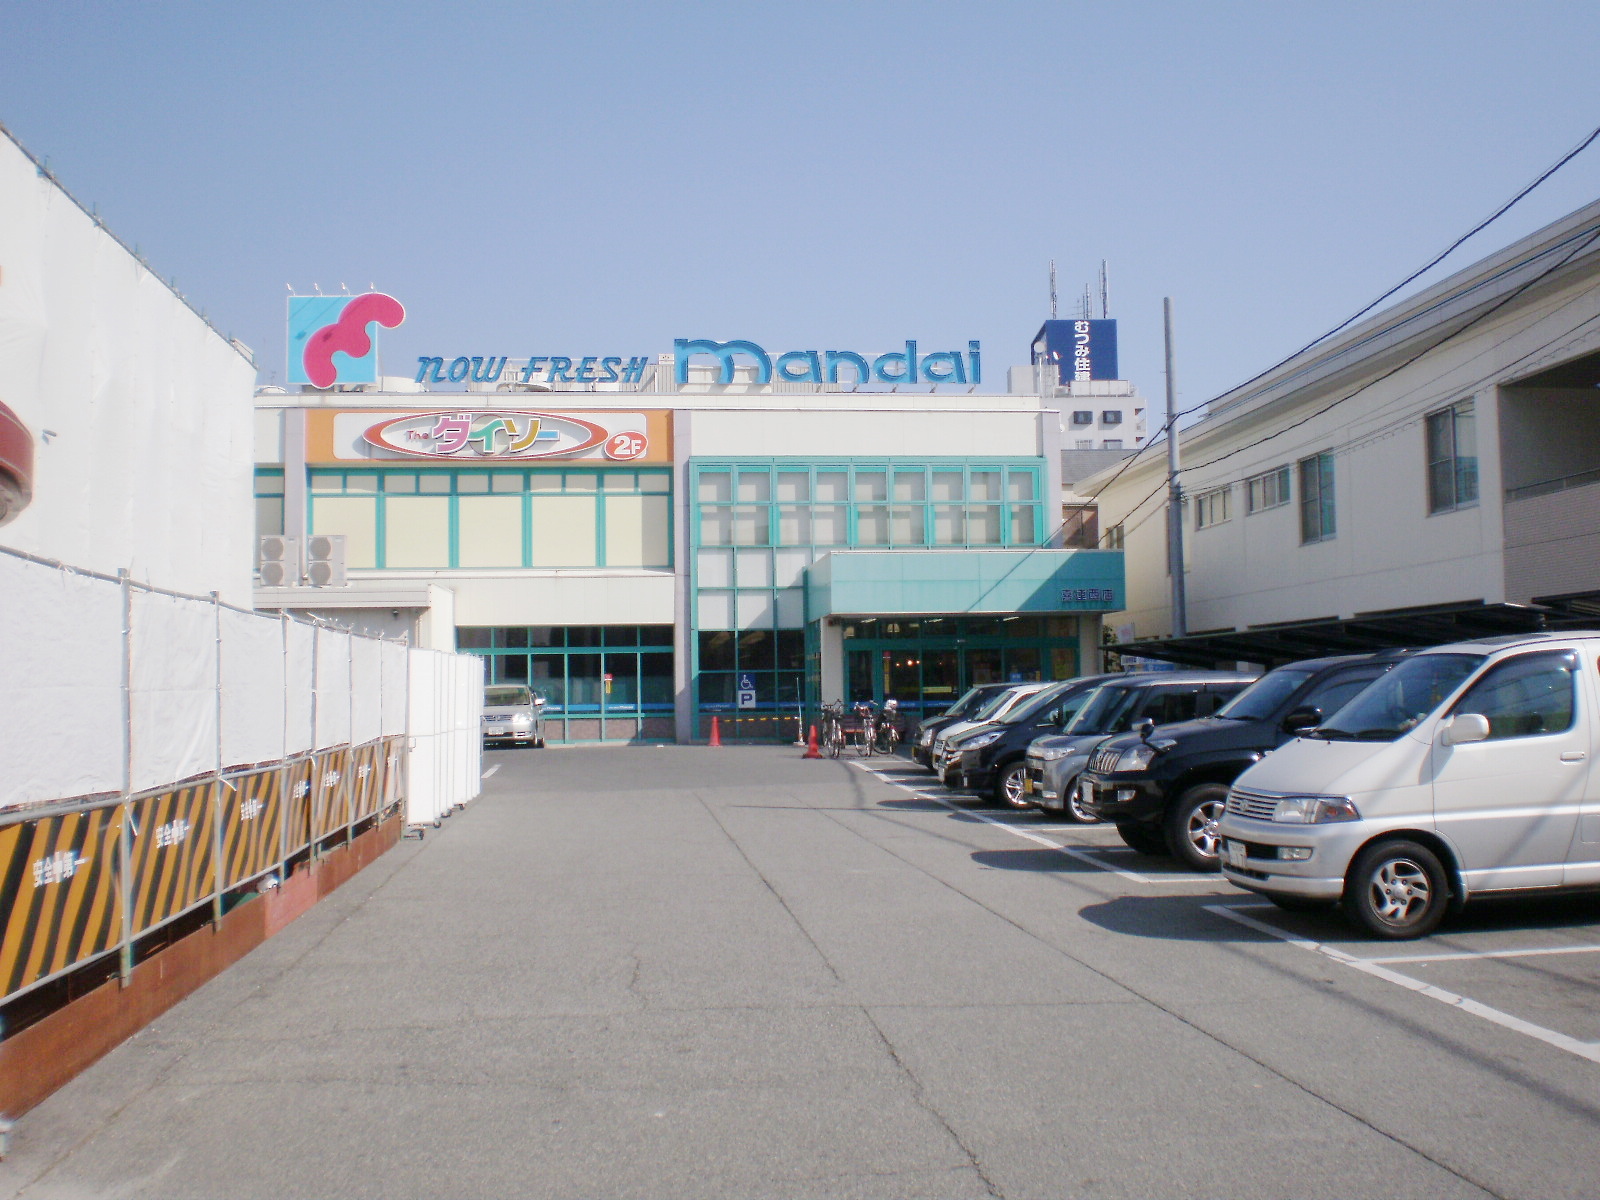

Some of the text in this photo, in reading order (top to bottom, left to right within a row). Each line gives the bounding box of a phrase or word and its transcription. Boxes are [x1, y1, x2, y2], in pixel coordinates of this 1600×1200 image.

[521, 356, 649, 383] FRESH
[674, 338, 981, 384] mandai
[406, 413, 560, 454] The ダイソー
[614, 436, 642, 455] 2F
[741, 694, 753, 705] P
